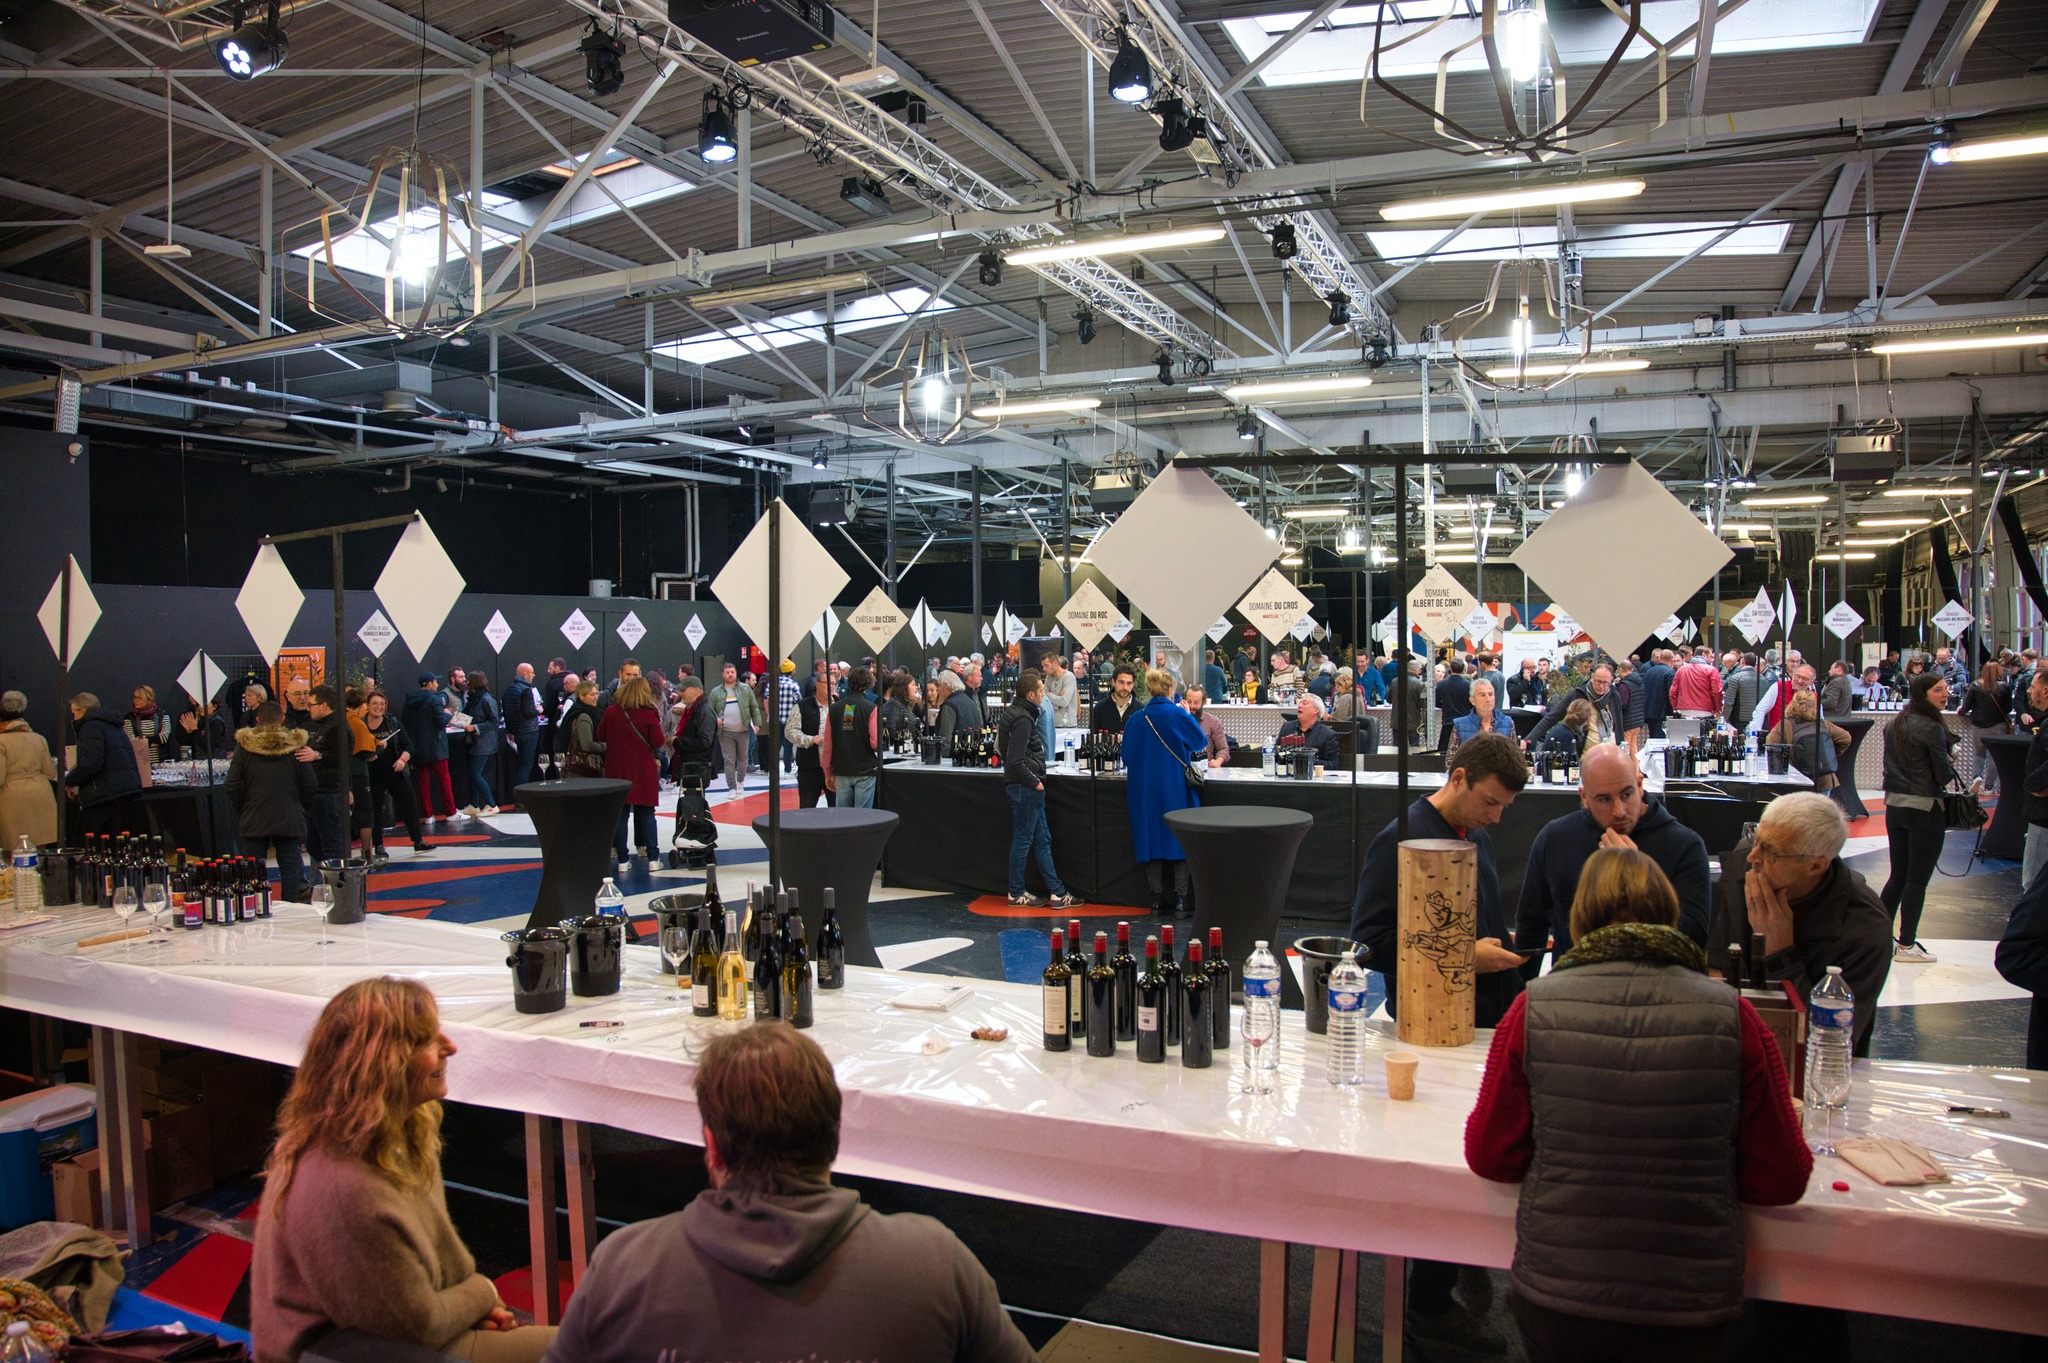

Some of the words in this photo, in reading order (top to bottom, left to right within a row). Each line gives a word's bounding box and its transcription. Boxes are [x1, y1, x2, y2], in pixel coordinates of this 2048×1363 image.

[1425, 589, 1450, 598] DOMAINE
[1249, 602, 1273, 611] DOMAINE
[1283, 601, 1298, 609] CROS
[1412, 599, 1435, 608] ALBERT
[1436, 599, 1443, 607] DE
[1444, 599, 1462, 607] CONTI
[856, 615, 875, 623] CHÂTEAU
[882, 615, 897, 623] CÈDRE
[1068, 611, 1089, 619] DOMAINE
[1090, 611, 1097, 619] DU
[1098, 611, 1108, 619] ROC
